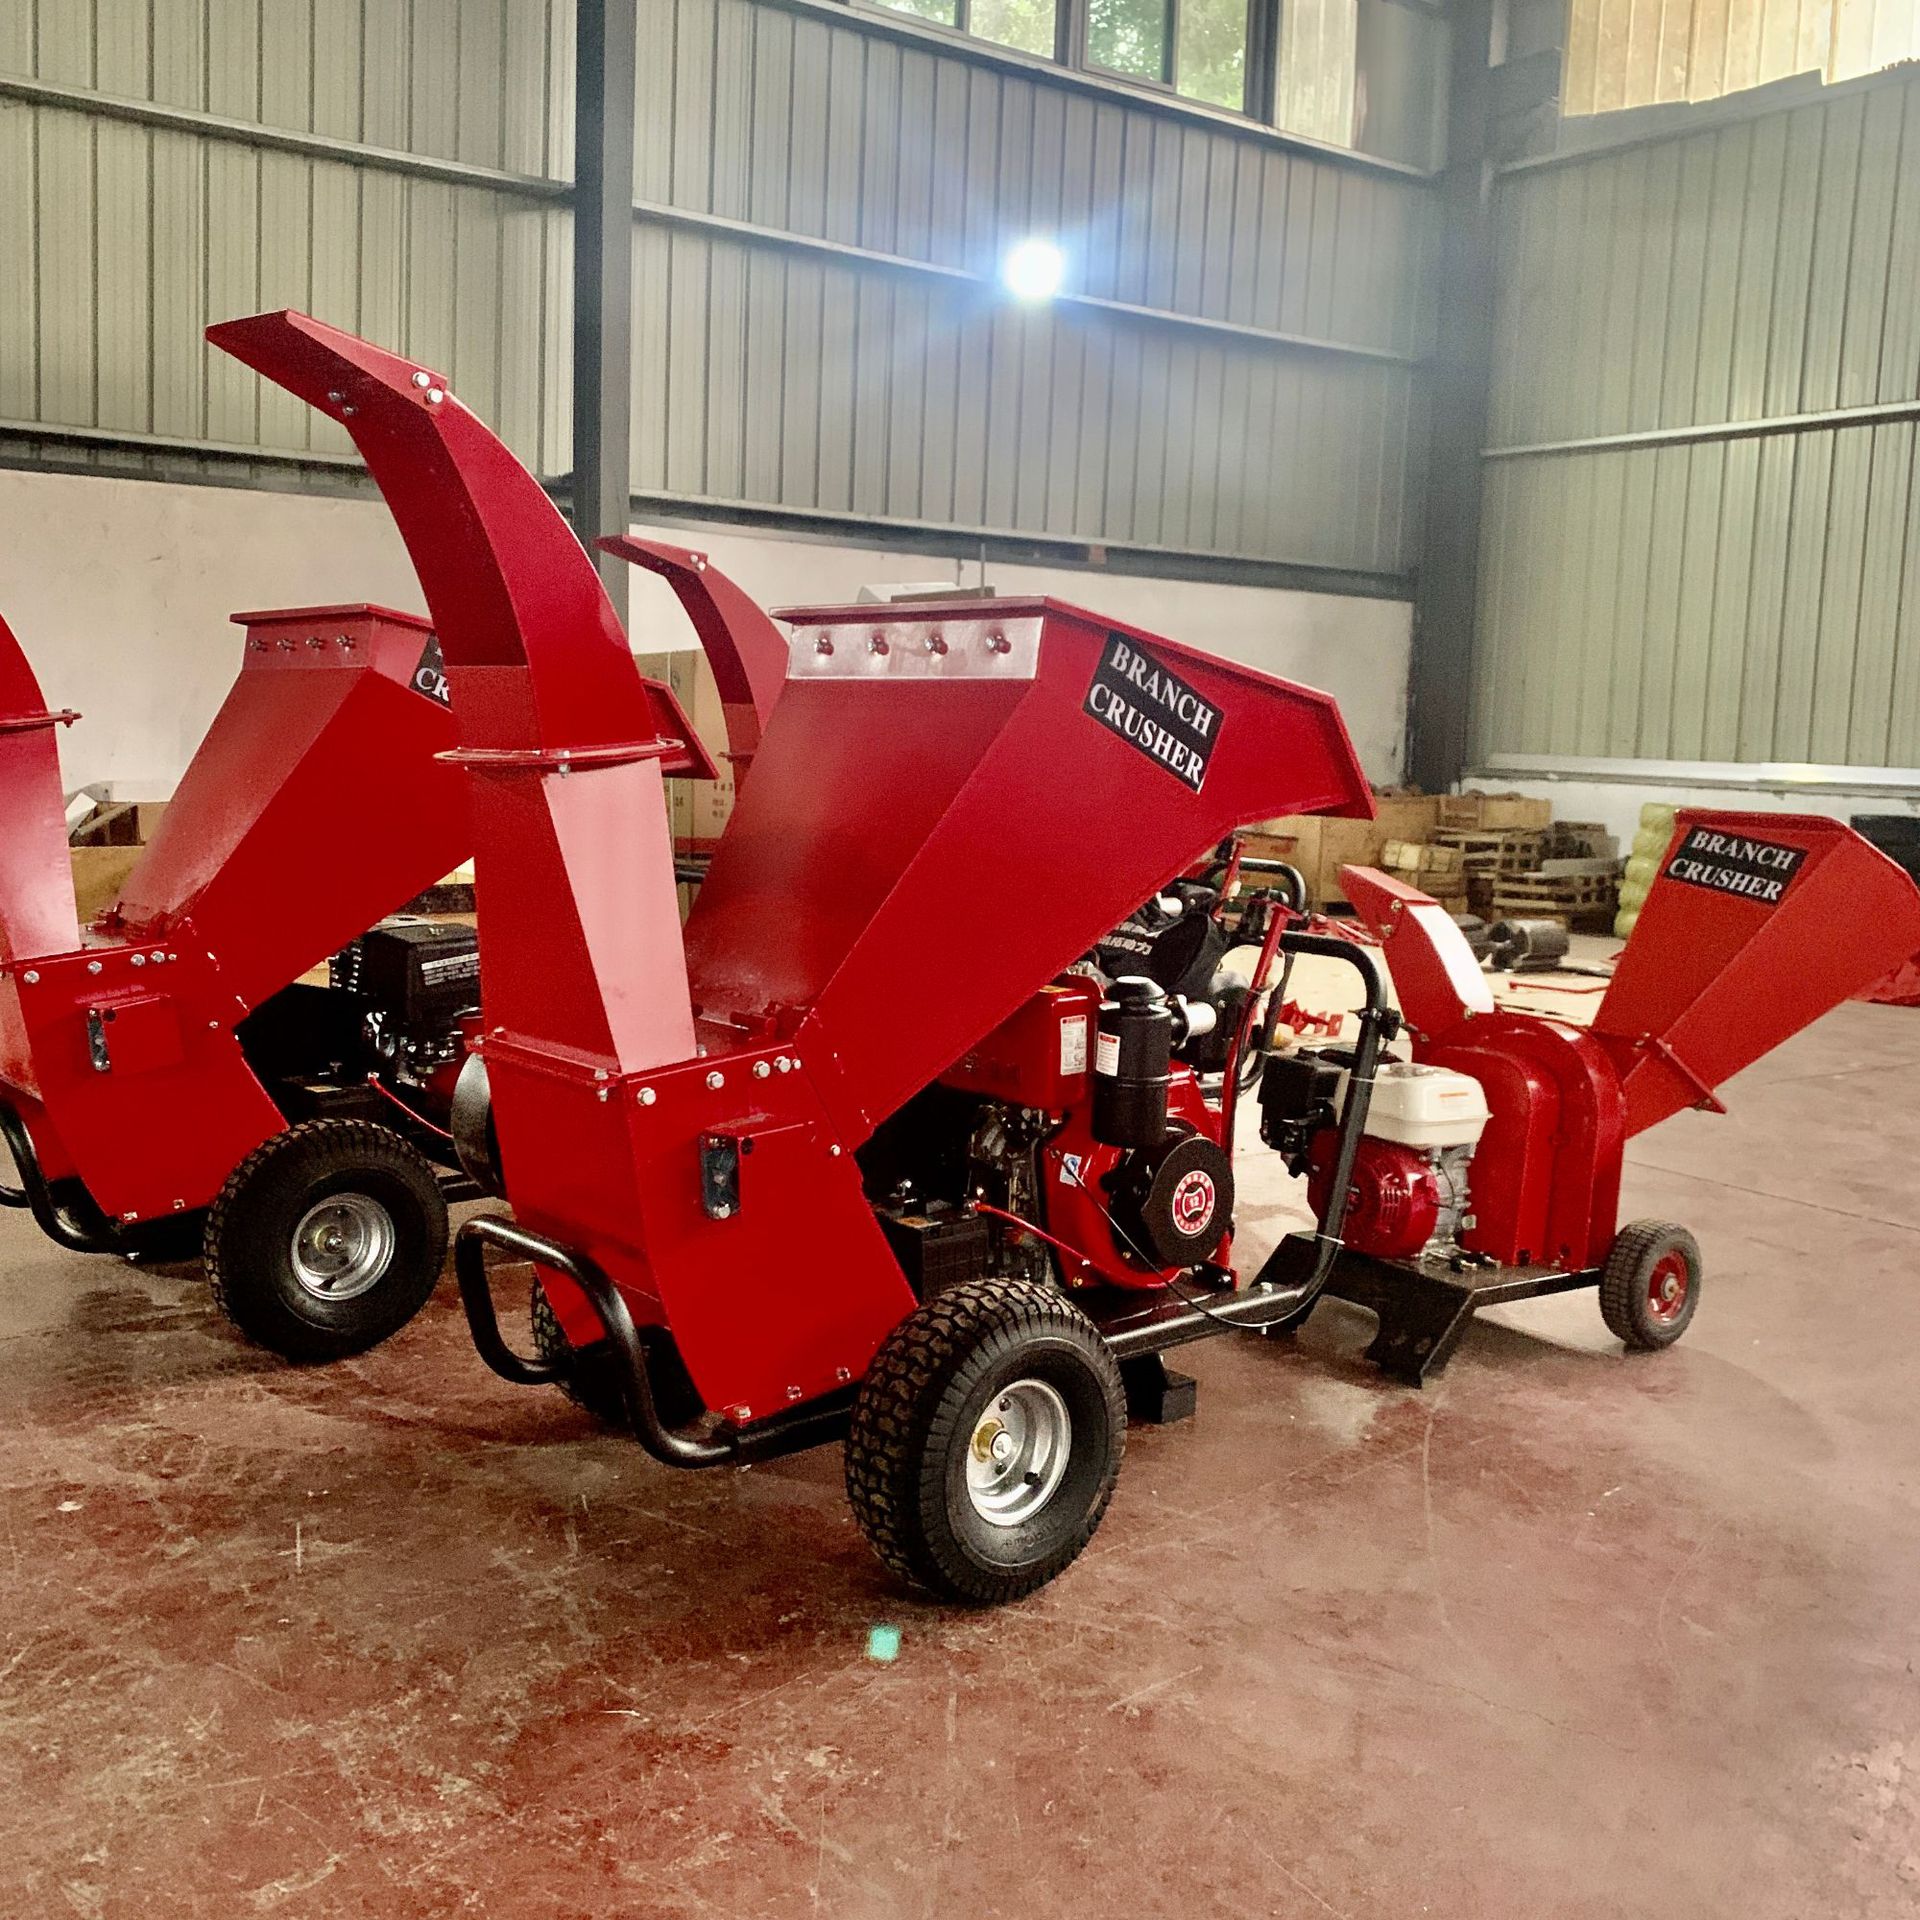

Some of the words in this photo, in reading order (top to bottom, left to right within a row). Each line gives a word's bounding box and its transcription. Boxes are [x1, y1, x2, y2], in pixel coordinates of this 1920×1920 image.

[1110, 641, 1214, 737] BRANCH
[1089, 683, 1204, 783] CRUSHER
[1669, 858, 1783, 901] CRUSHER
[1690, 831, 1797, 870] BRANCH
